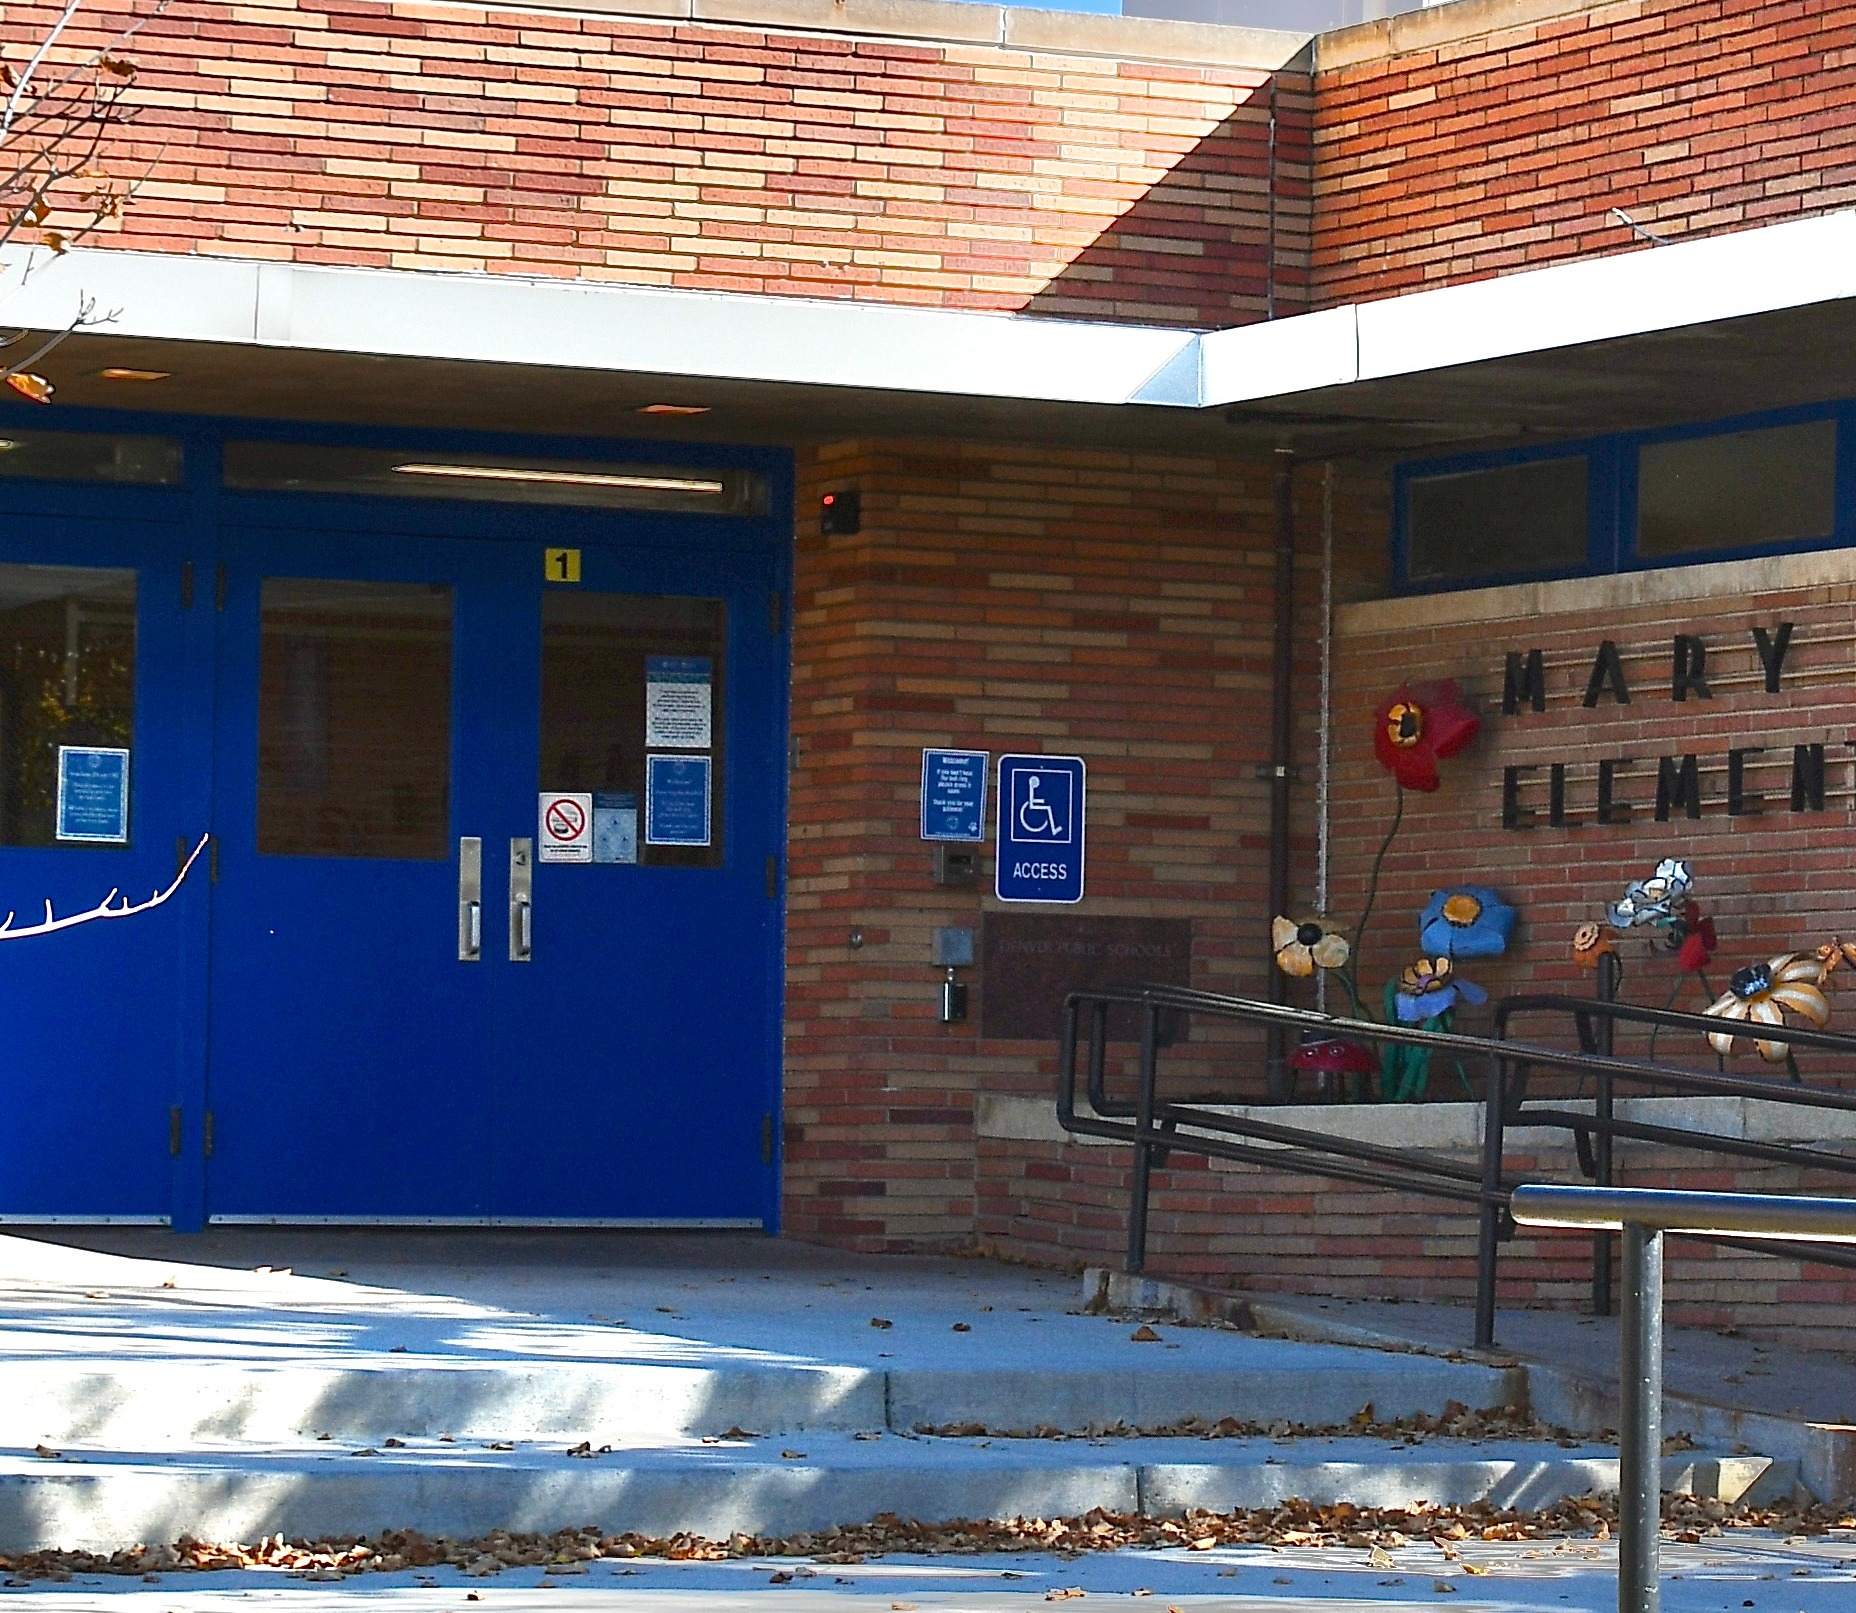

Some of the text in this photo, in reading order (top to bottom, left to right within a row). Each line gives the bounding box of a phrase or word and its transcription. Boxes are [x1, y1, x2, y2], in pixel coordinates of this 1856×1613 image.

[555, 552, 568, 579] 1
[1502, 622, 1794, 716] MARY
[1013, 862, 1067, 880] ACCESS
